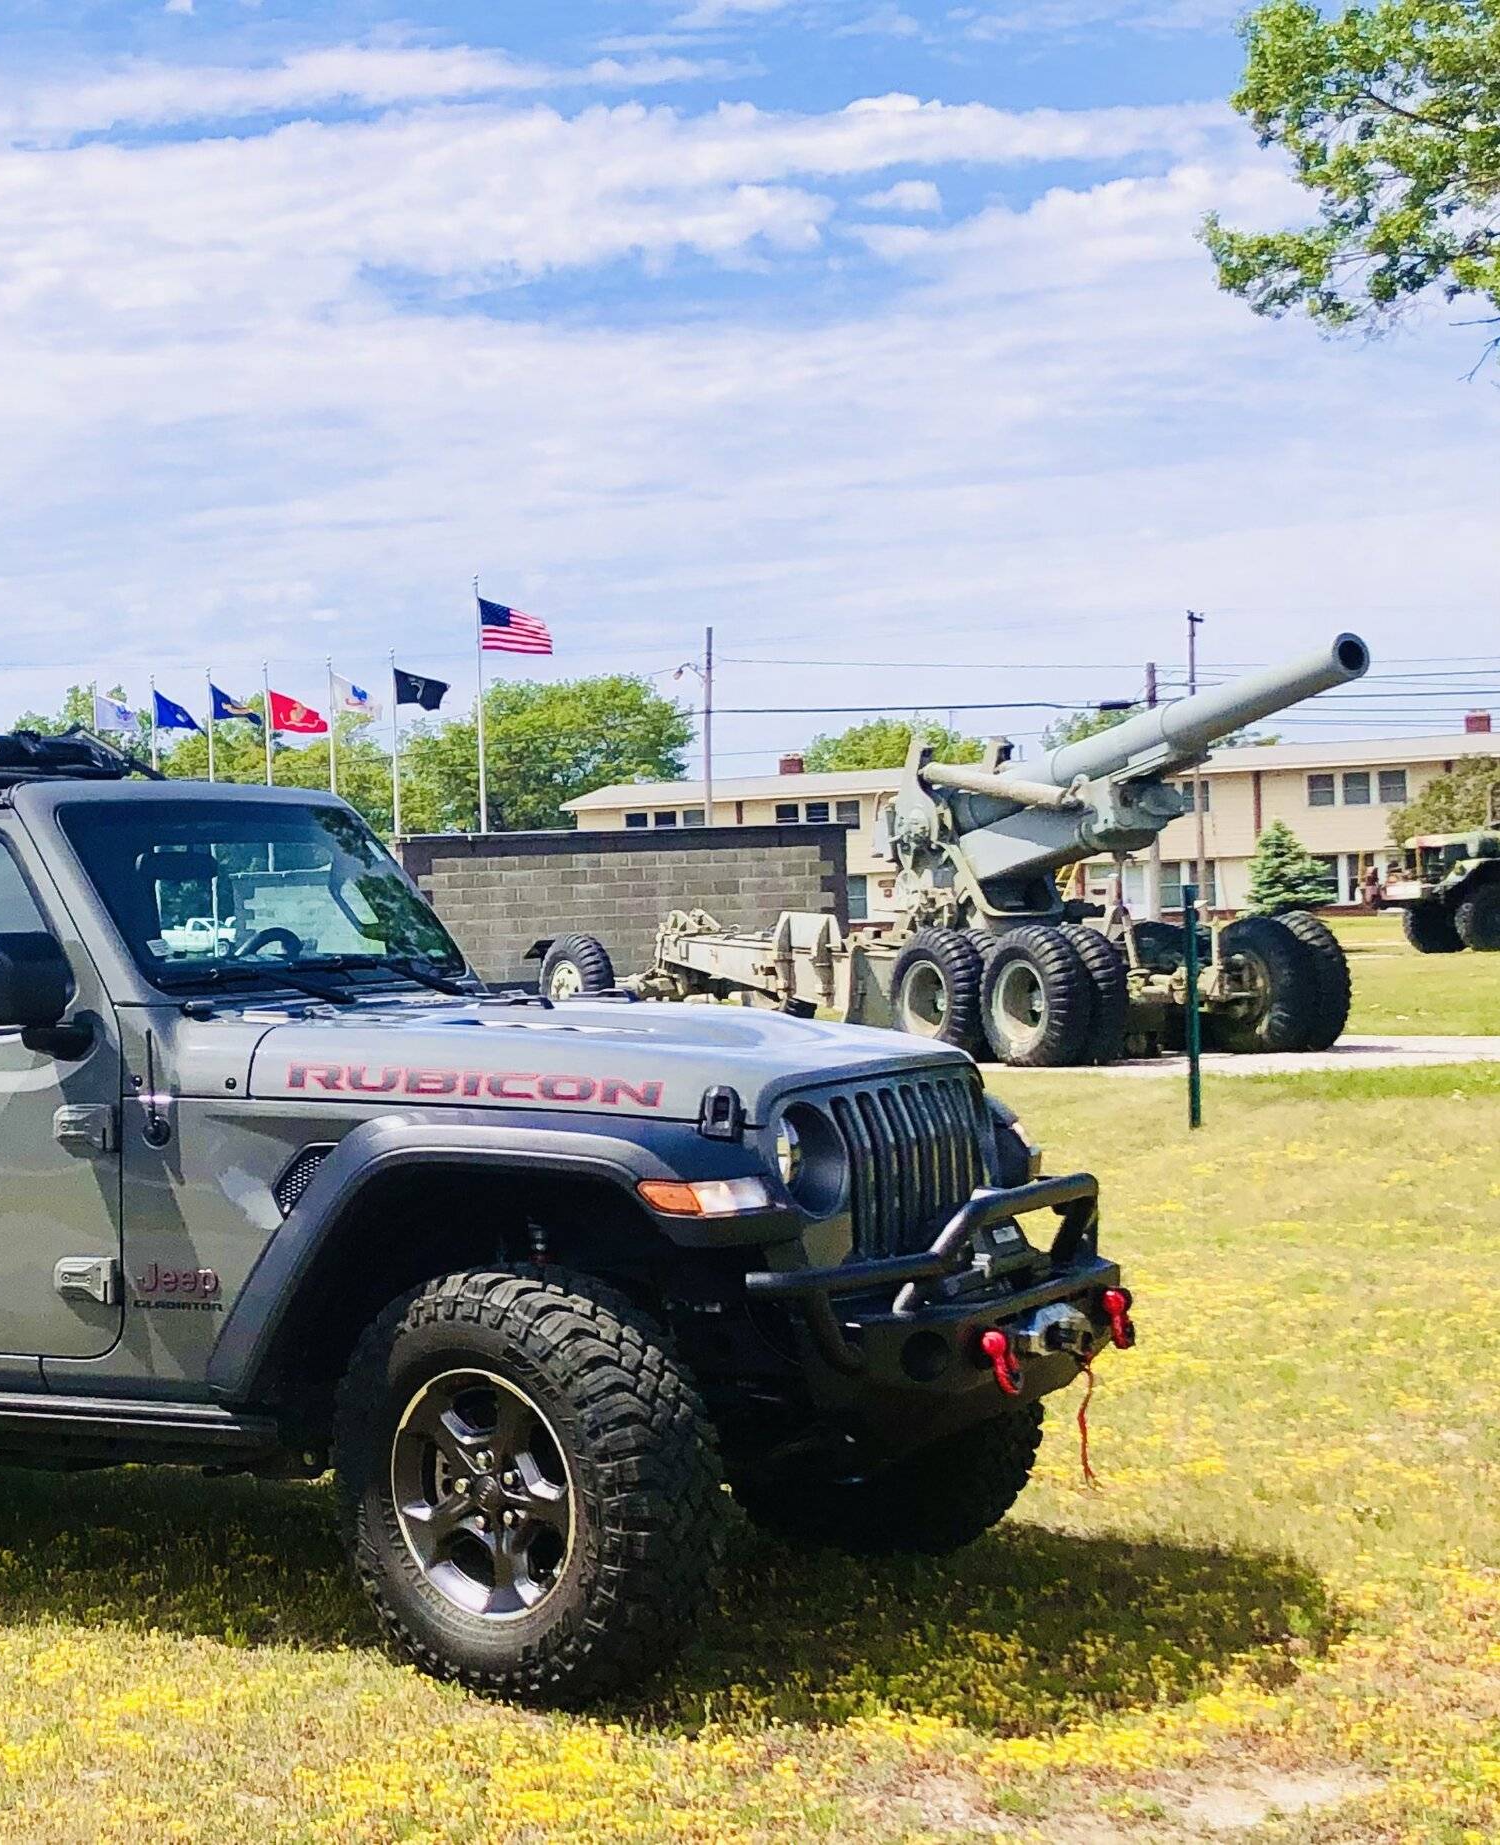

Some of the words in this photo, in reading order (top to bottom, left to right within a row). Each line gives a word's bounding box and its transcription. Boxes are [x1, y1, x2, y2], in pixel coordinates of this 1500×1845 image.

[287, 1062, 664, 1108] RUBICON
[136, 1262, 220, 1298] Jeep
[134, 1301, 223, 1312] GLADIATOR
